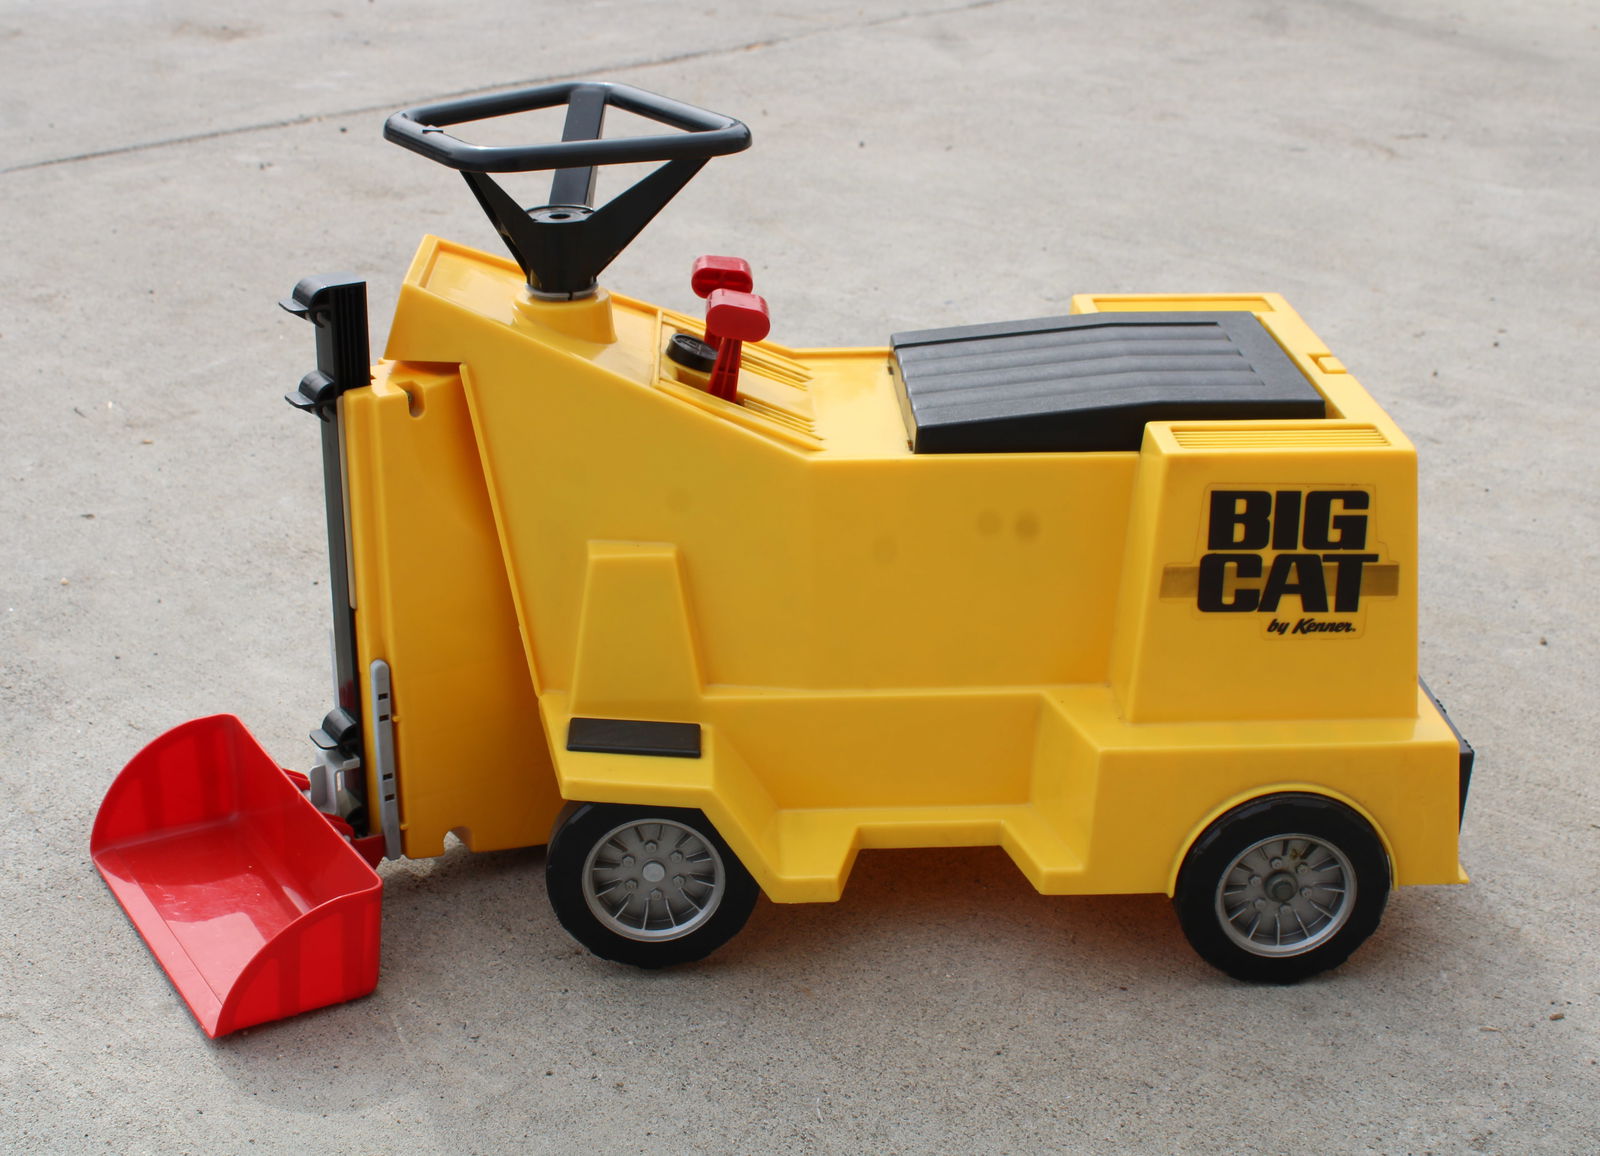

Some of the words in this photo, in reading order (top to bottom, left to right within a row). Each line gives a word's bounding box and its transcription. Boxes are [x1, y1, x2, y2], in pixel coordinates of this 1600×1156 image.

[1208, 490, 1370, 550] BIG
[1197, 553, 1379, 613] CAT
[1267, 618, 1290, 635] by
